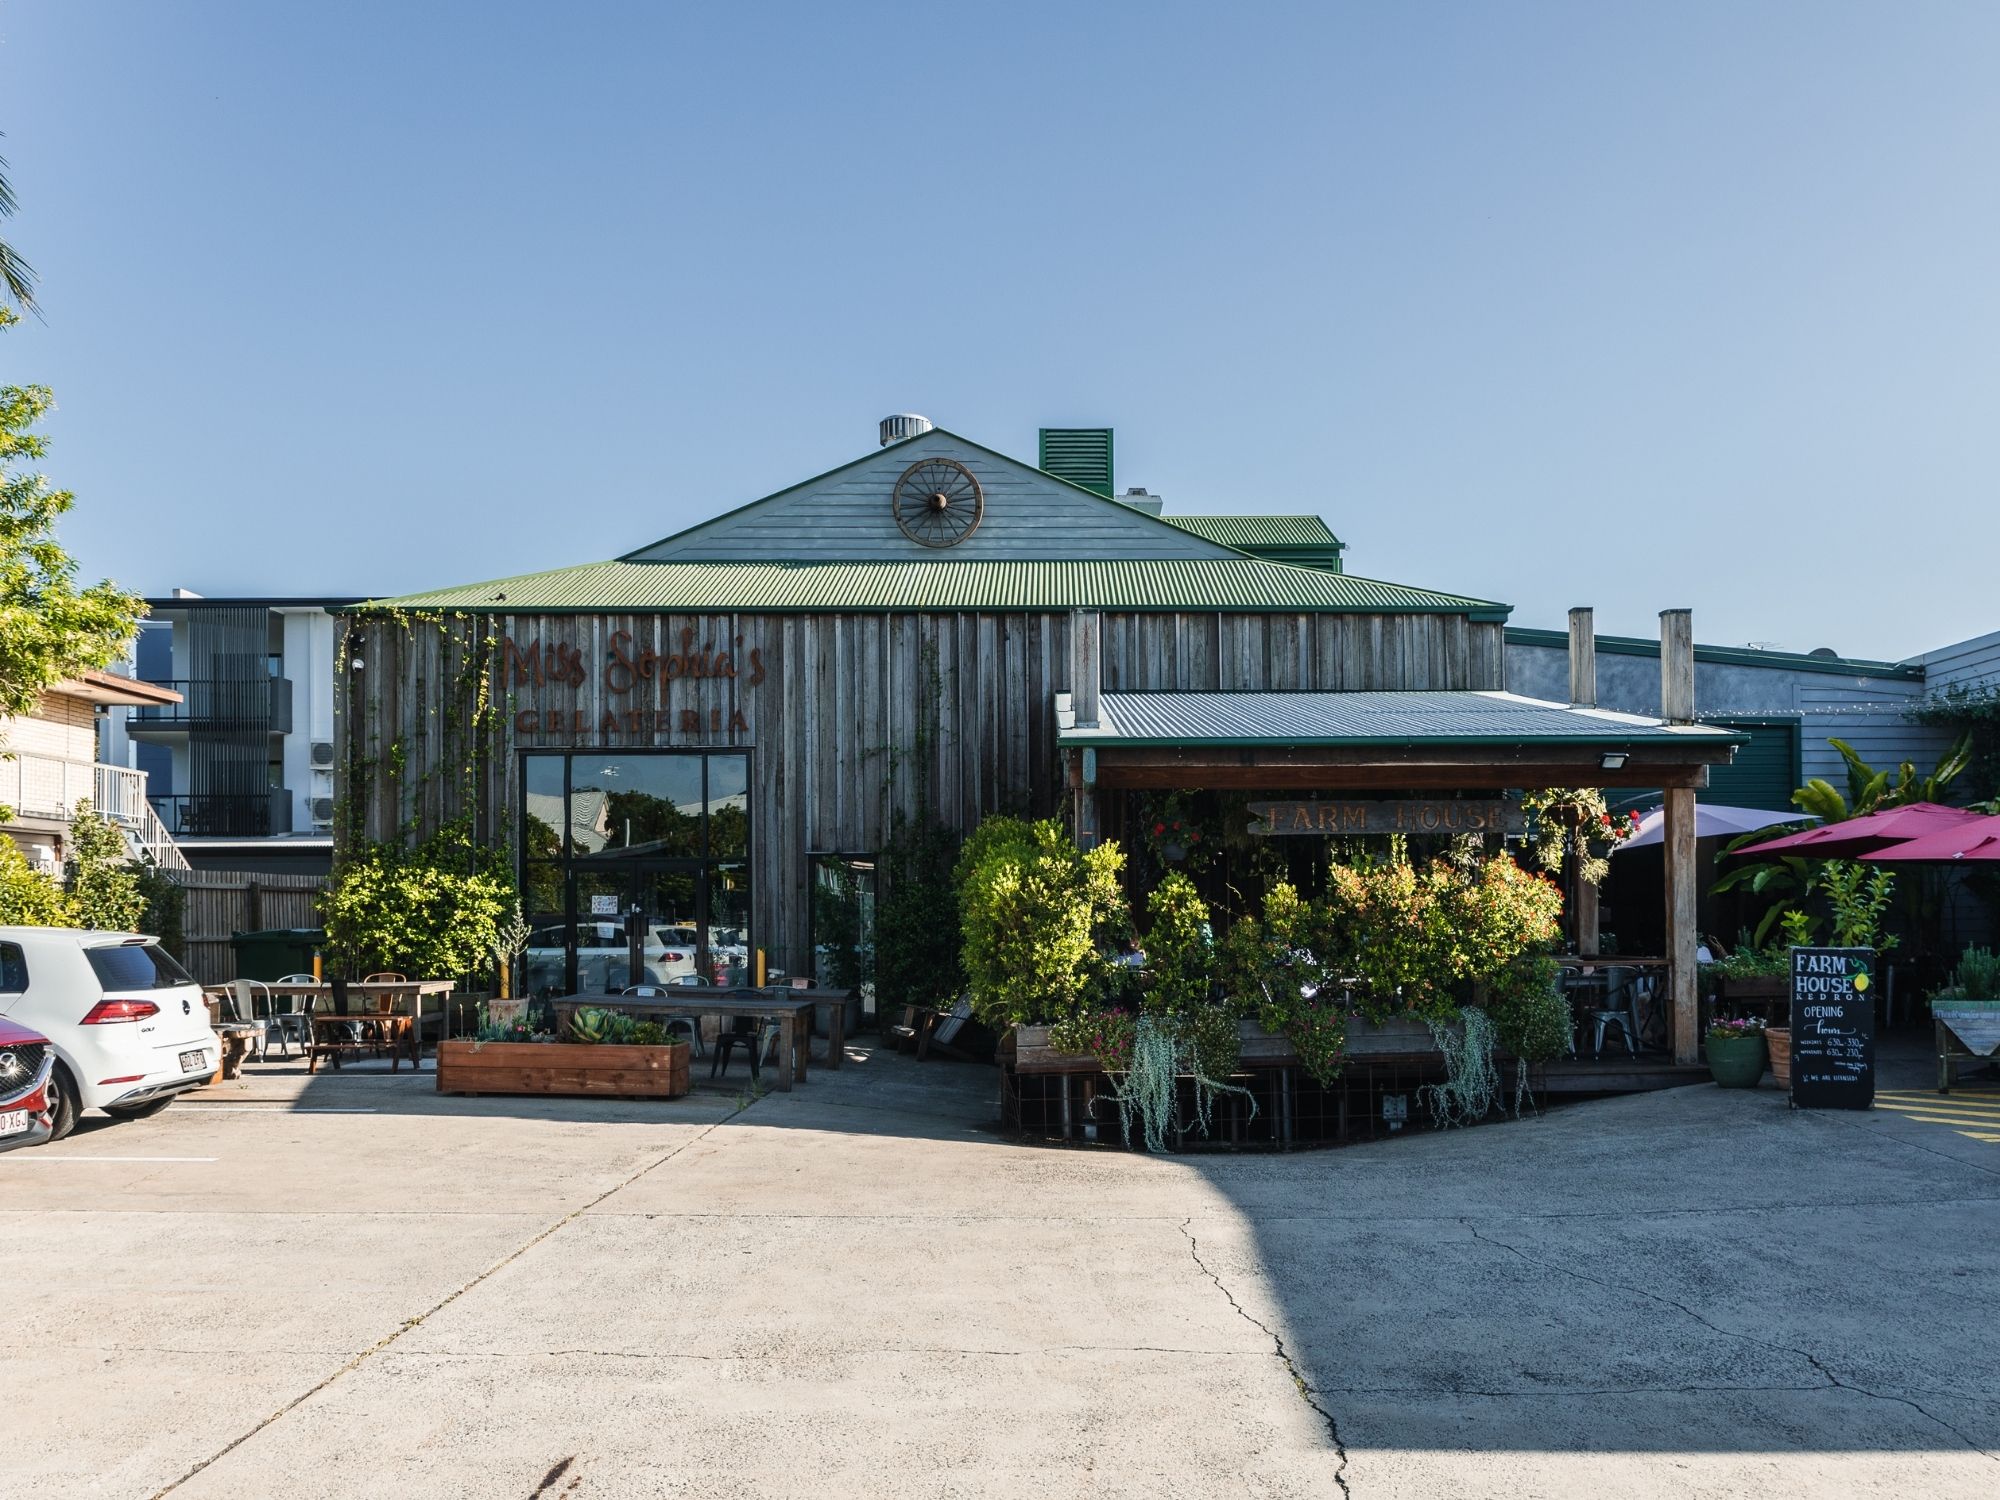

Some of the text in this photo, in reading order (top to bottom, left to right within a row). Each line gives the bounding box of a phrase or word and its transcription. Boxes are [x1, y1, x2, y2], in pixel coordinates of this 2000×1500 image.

[501, 627, 765, 703] Miss Sophia's
[515, 708, 750, 733] GELATERIA
[1268, 804, 1506, 832] FARM HOUSE
[1796, 954, 1847, 974] FARM
[1796, 976, 1853, 993] HOUSE
[1804, 1006, 1843, 1017] OPENING
